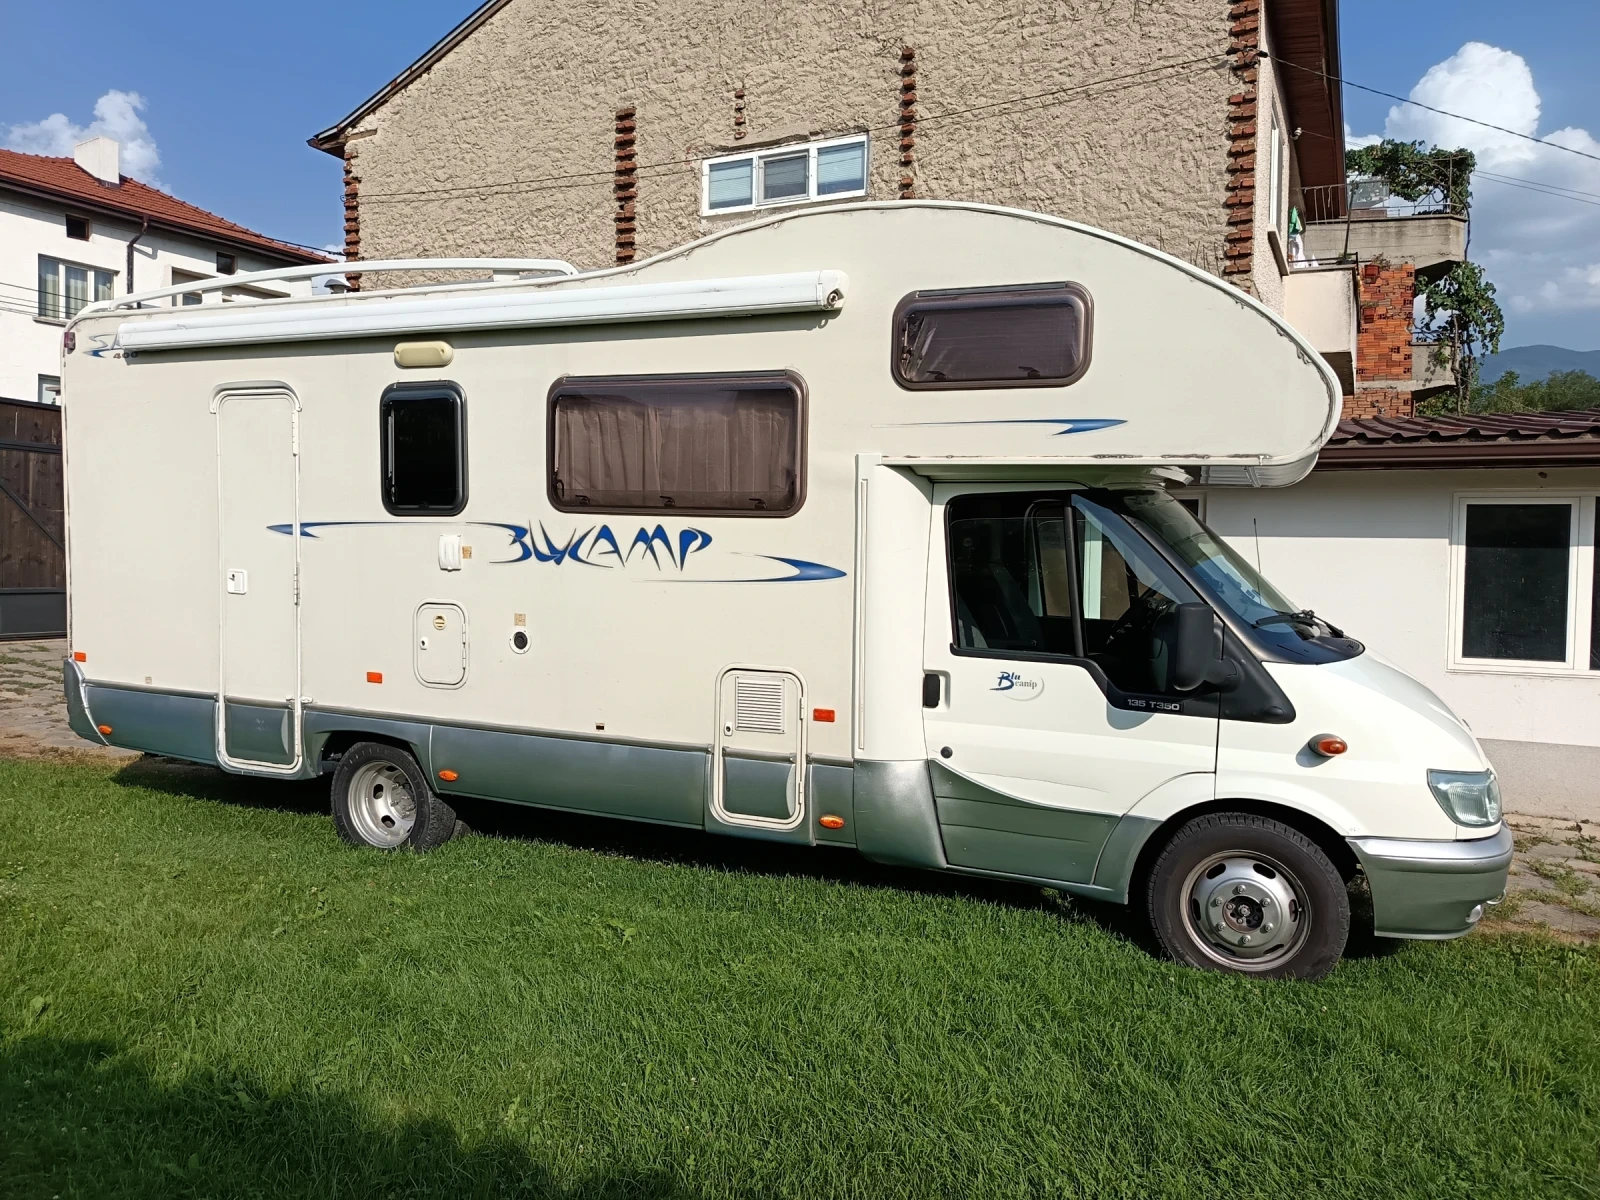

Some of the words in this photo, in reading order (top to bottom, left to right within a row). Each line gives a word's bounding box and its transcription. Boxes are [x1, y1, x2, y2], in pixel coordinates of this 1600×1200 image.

[113, 351, 139, 359] 400
[989, 671, 1021, 691] Blu
[1014, 680, 1038, 690] camp
[1127, 698, 1146, 707] 135
[1149, 701, 1180, 711] T350
